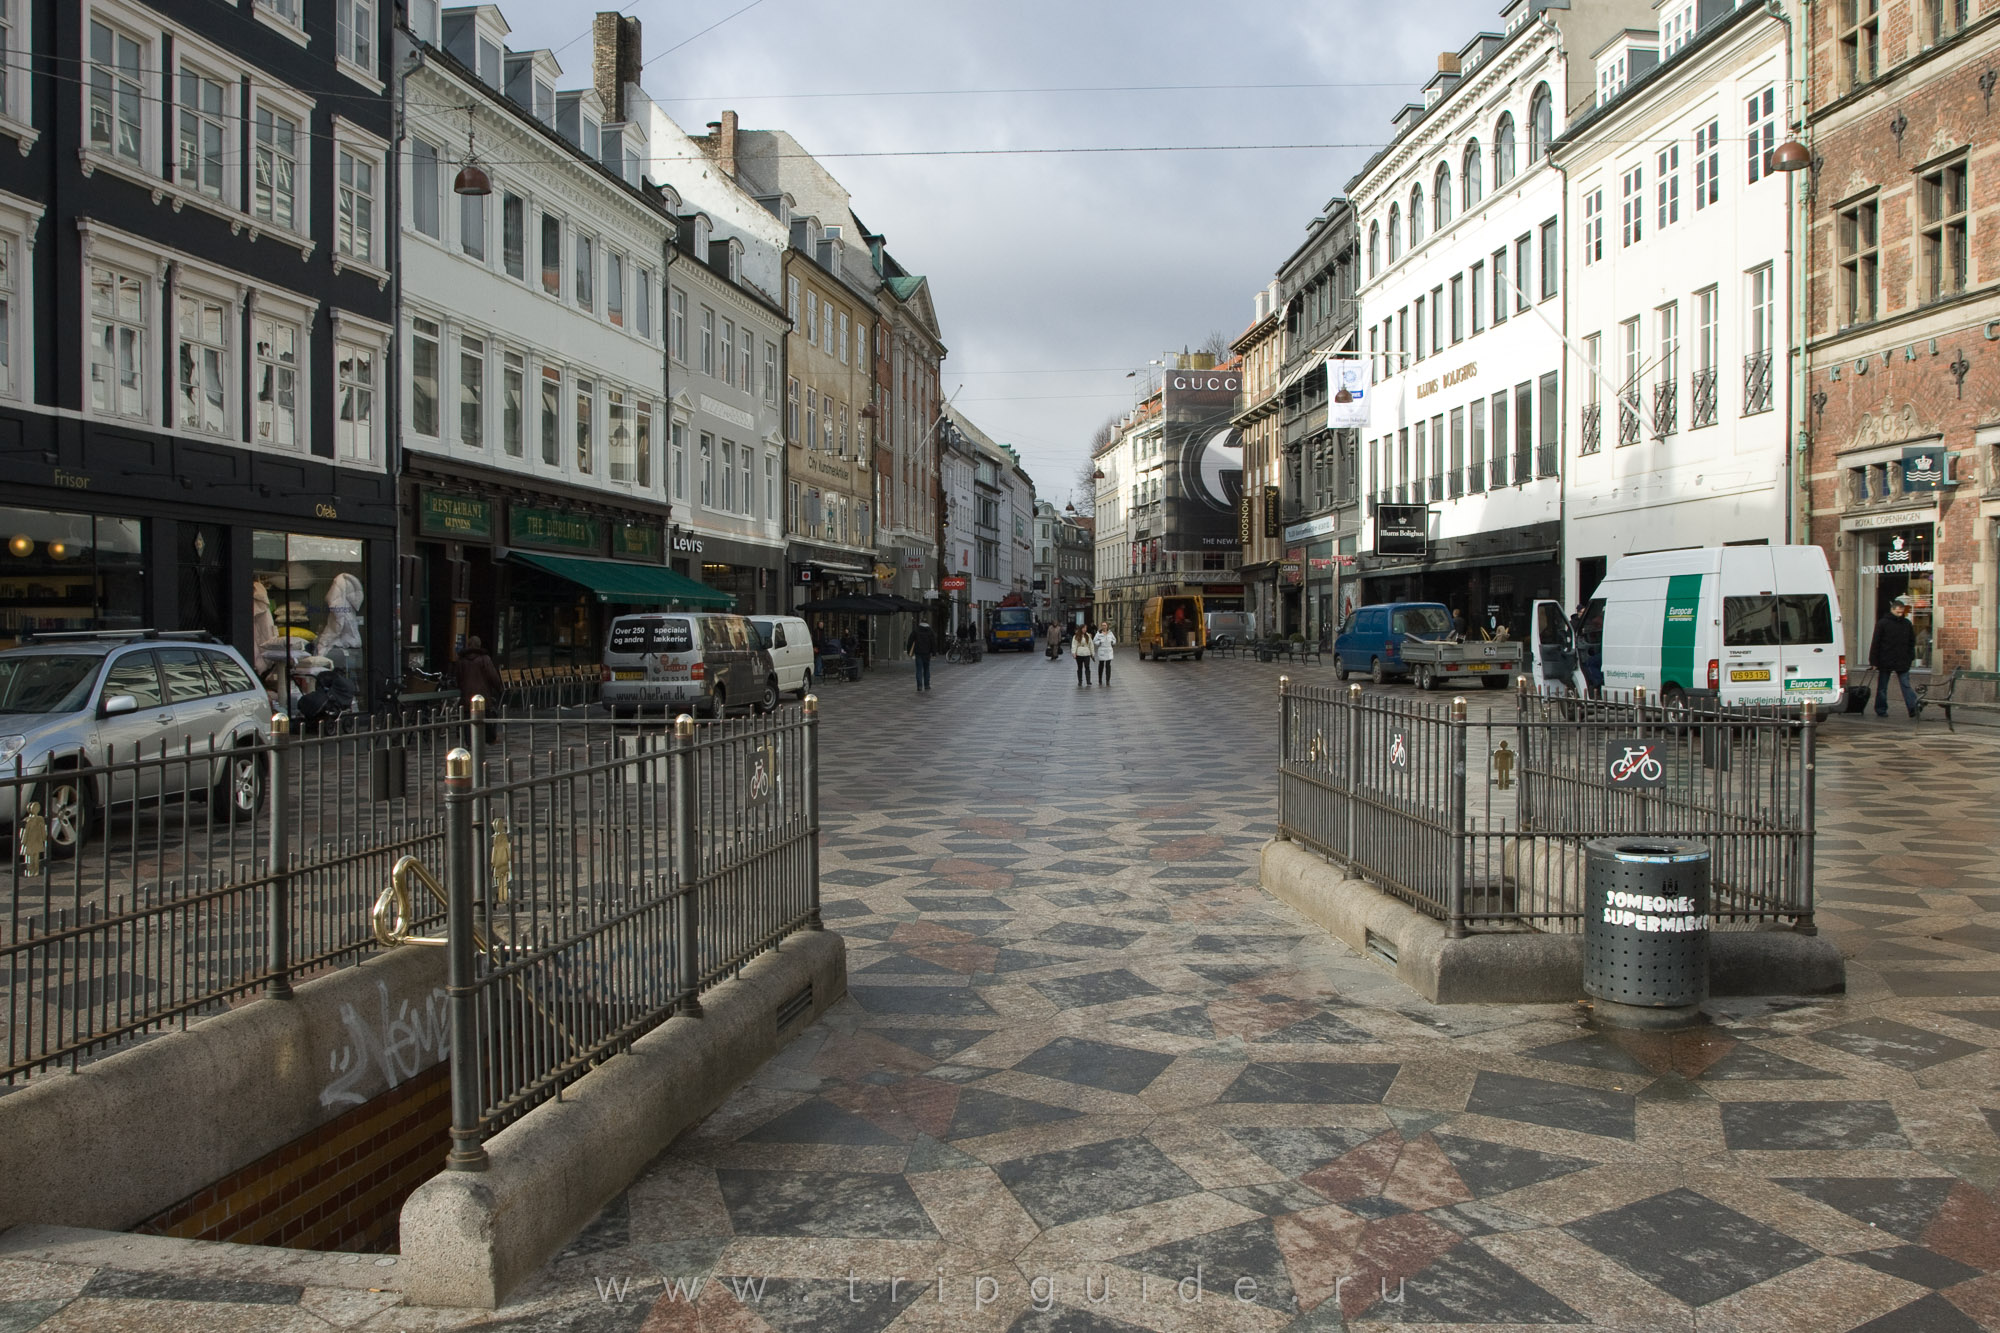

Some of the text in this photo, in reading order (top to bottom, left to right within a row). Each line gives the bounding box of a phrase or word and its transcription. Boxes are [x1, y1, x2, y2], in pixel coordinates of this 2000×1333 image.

[1829, 338, 1939, 383] ROYAL
[1443, 361, 1478, 389] BOLIGHUS
[1173, 376, 1243, 391] GUCC
[54, 468, 91, 489] Frisør
[432, 497, 483, 519] RESTAURANT
[527, 516, 544, 536] THE
[1855, 512, 1921, 527] ROYAL COPENHAGEN
[1203, 537, 1215, 545] THE
[1380, 529, 1425, 539] Illums Bolighus
[1860, 564, 1885, 575] ROYAL
[1669, 606, 1694, 616] Europcar
[1790, 680, 1828, 690] Europcar
[1738, 697, 1786, 705] Biludlejning
[1606, 890, 1696, 913] SOMEONES
